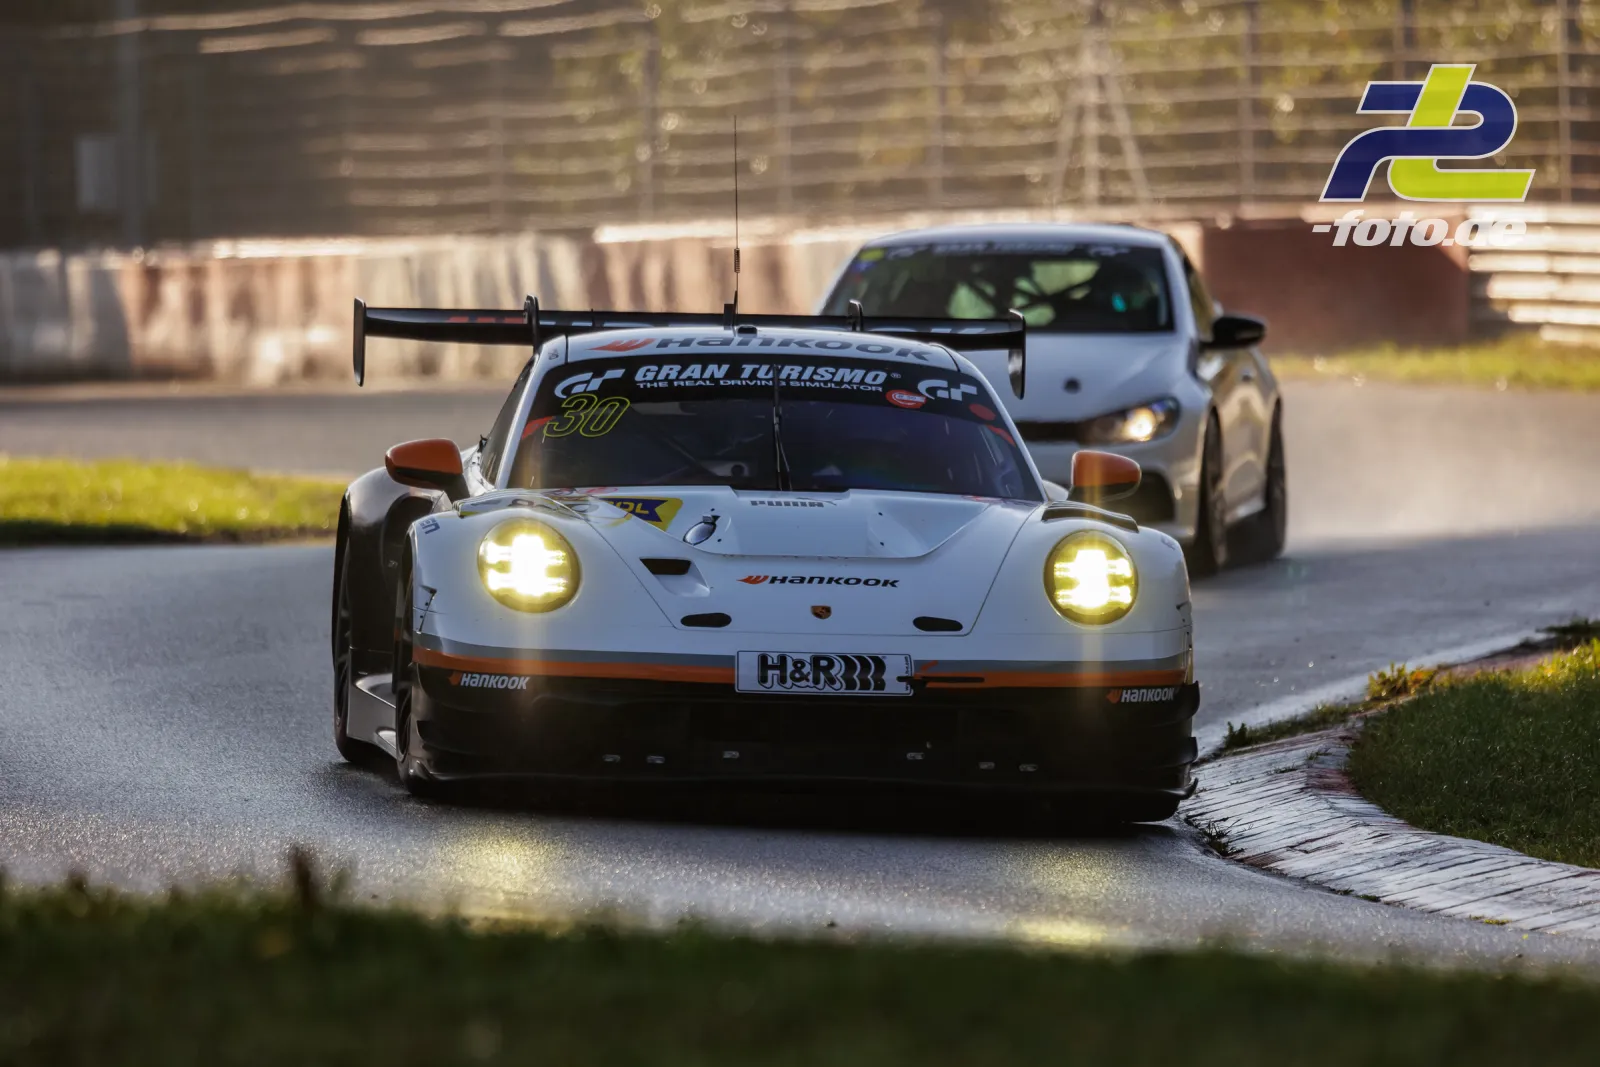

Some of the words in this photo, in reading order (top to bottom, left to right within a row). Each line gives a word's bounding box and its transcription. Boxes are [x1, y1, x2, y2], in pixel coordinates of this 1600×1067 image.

[554, 368, 626, 399] GT
[634, 364, 730, 381] GRAN
[740, 364, 888, 385] TURISMO
[636, 380, 669, 389] THE
[674, 379, 715, 387] REAL
[789, 380, 883, 393] SIMULATOR
[917, 379, 978, 401] GT
[543, 393, 631, 437] 30
